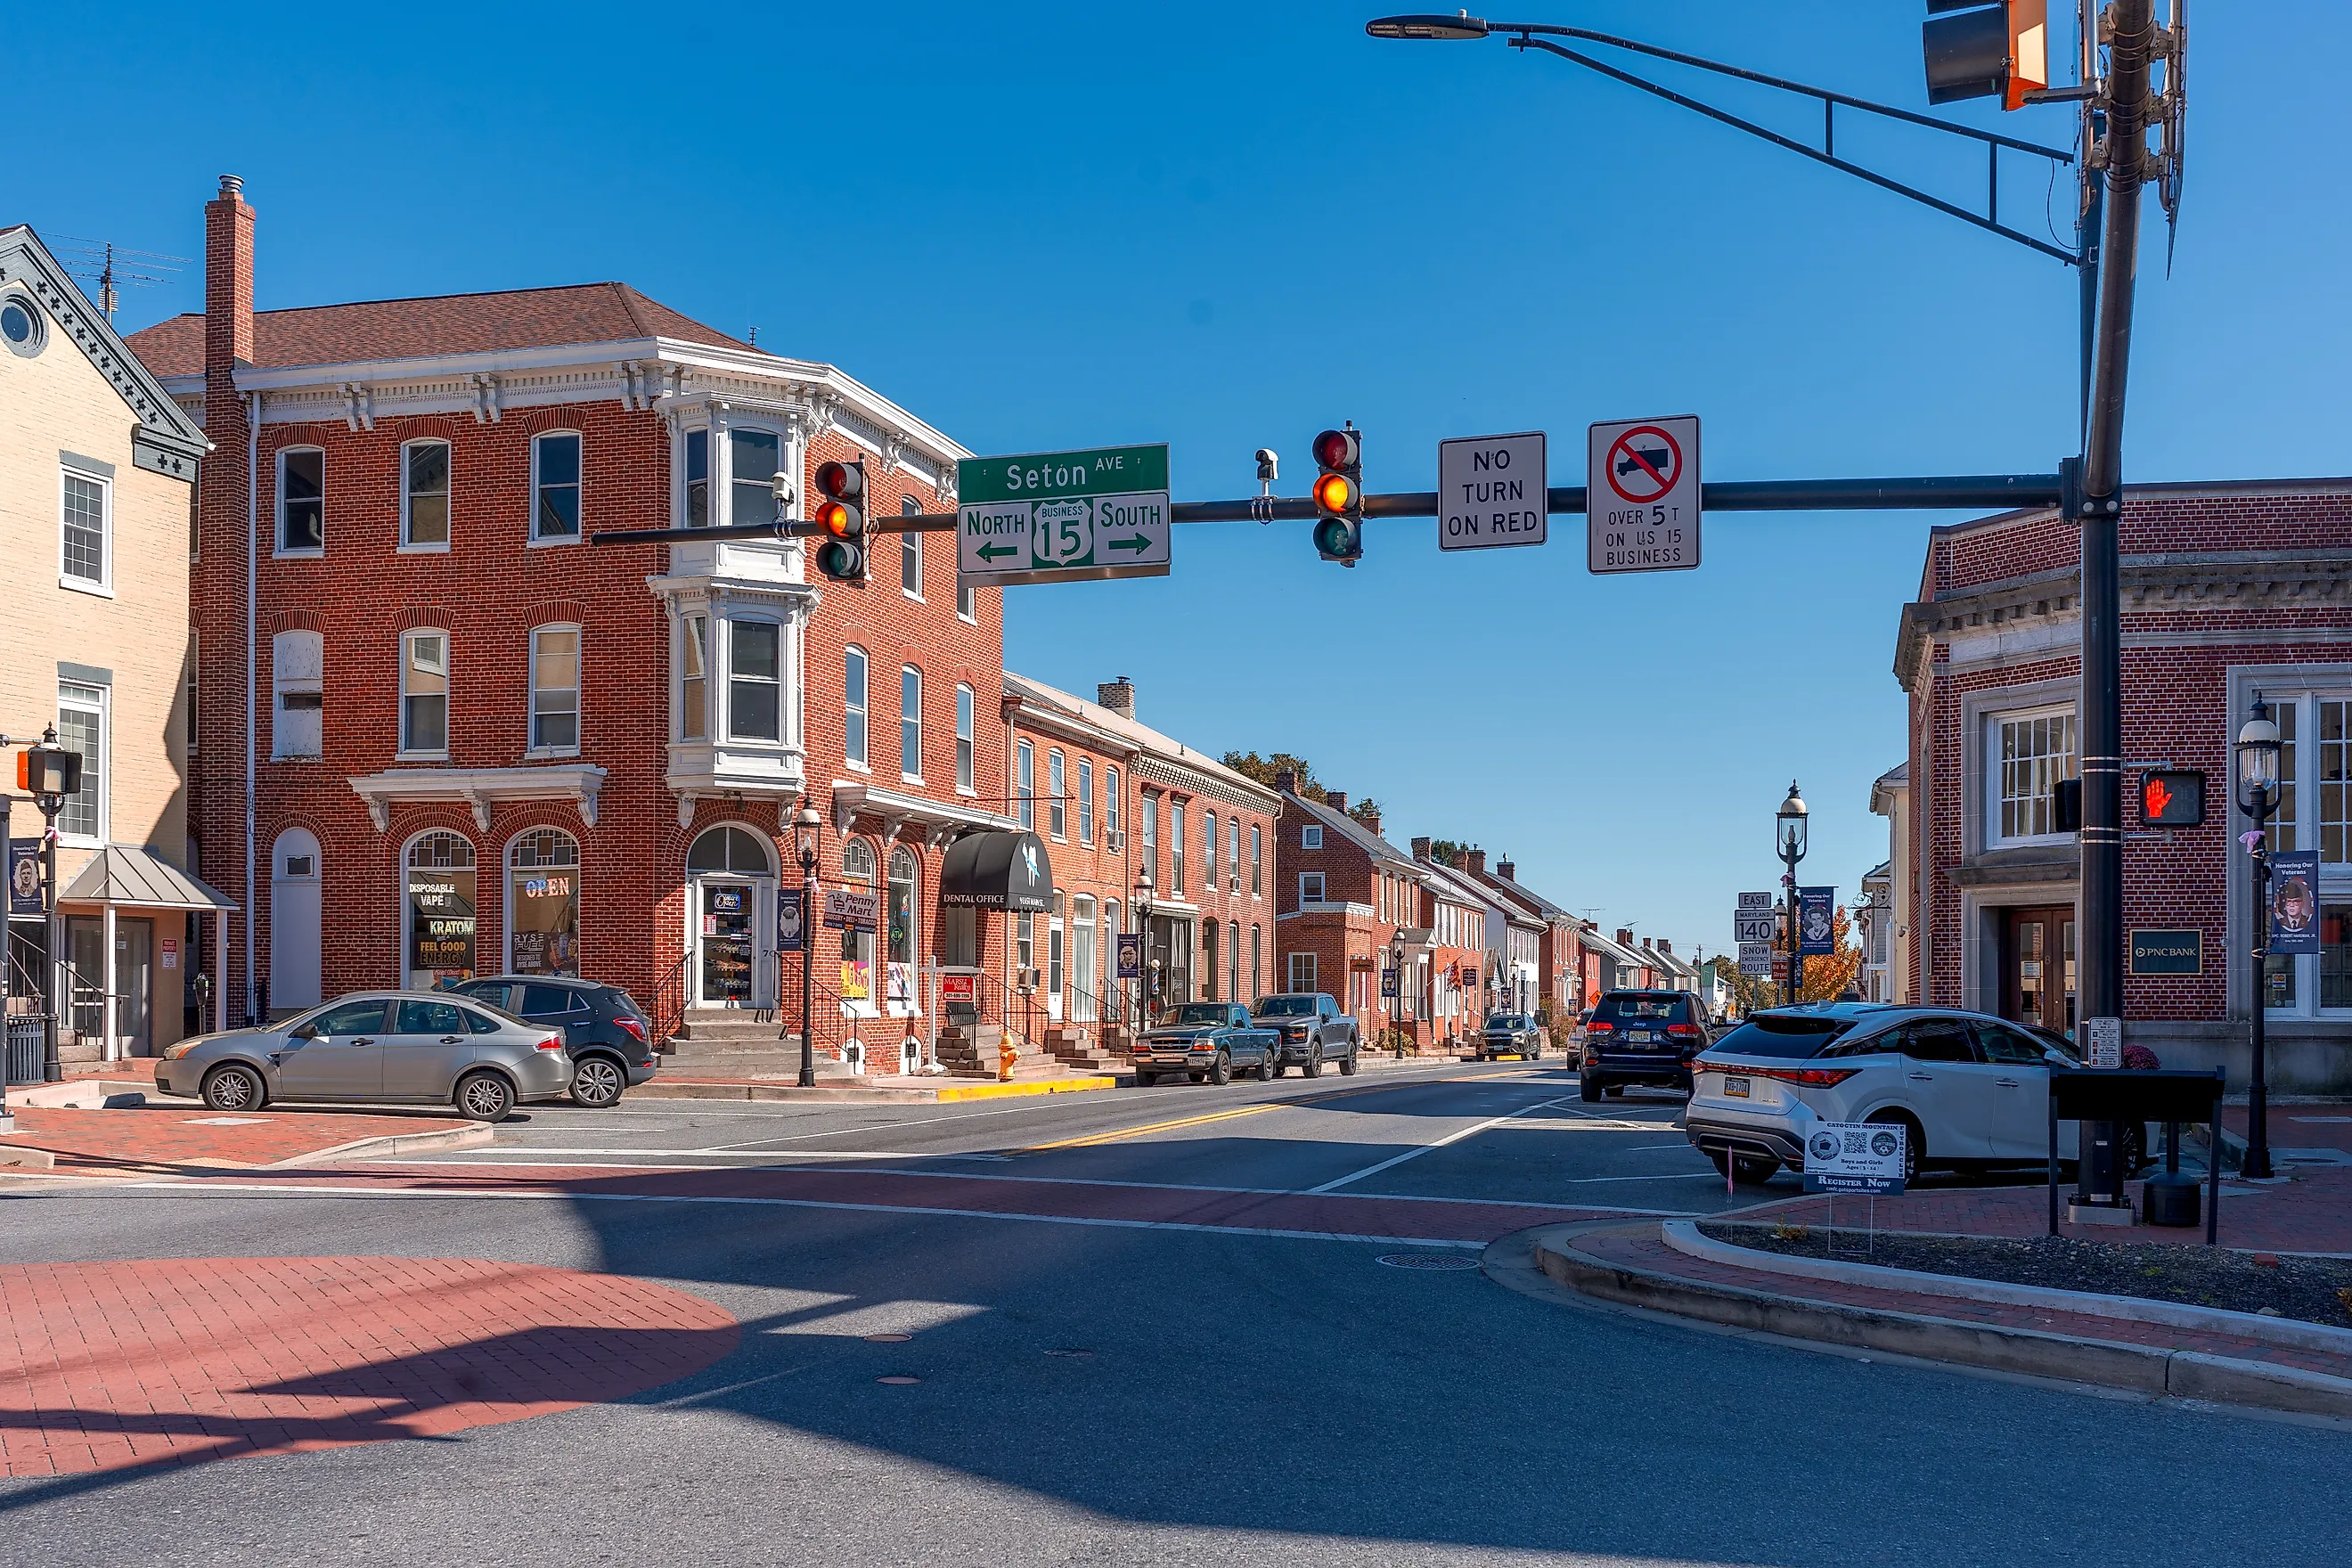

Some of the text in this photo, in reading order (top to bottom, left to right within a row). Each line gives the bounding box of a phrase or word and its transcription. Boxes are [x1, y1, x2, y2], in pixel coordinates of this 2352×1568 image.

[1474, 449, 1511, 472] NO
[1006, 455, 1124, 490] Seton AVE
[1462, 479, 1523, 504] TURN
[1041, 505, 1084, 519] BUSINESS
[1100, 502, 1162, 528] SOUTH
[1608, 504, 1679, 527] OVER 5 T
[967, 510, 1025, 536] NORTH
[1448, 510, 1538, 537] ON RED
[1041, 519, 1082, 559] 15
[1605, 528, 1682, 548] ON US 15
[1606, 547, 1681, 567] BUSINESS
[2275, 862, 2302, 870] Honoring
[409, 883, 455, 894] DISPOSABLE
[525, 877, 570, 899] OPEN
[420, 894, 445, 906] VAPE
[845, 894, 878, 909] Penny
[943, 894, 1004, 903] DENTAL OFFICE
[1744, 894, 1766, 905] EAST
[846, 904, 872, 917] Mart
[429, 920, 474, 935] KRATOM
[825, 913, 844, 922] GROCERY
[858, 918, 877, 927] TOBACCO
[1739, 921, 1771, 940] 140
[420, 941, 467, 951] FEEL GOOD
[1743, 946, 1768, 955] SNOW
[2146, 947, 2196, 957] PNC BANK
[420, 951, 467, 965] ENERGY
[1741, 963, 1770, 973] ROUTE
